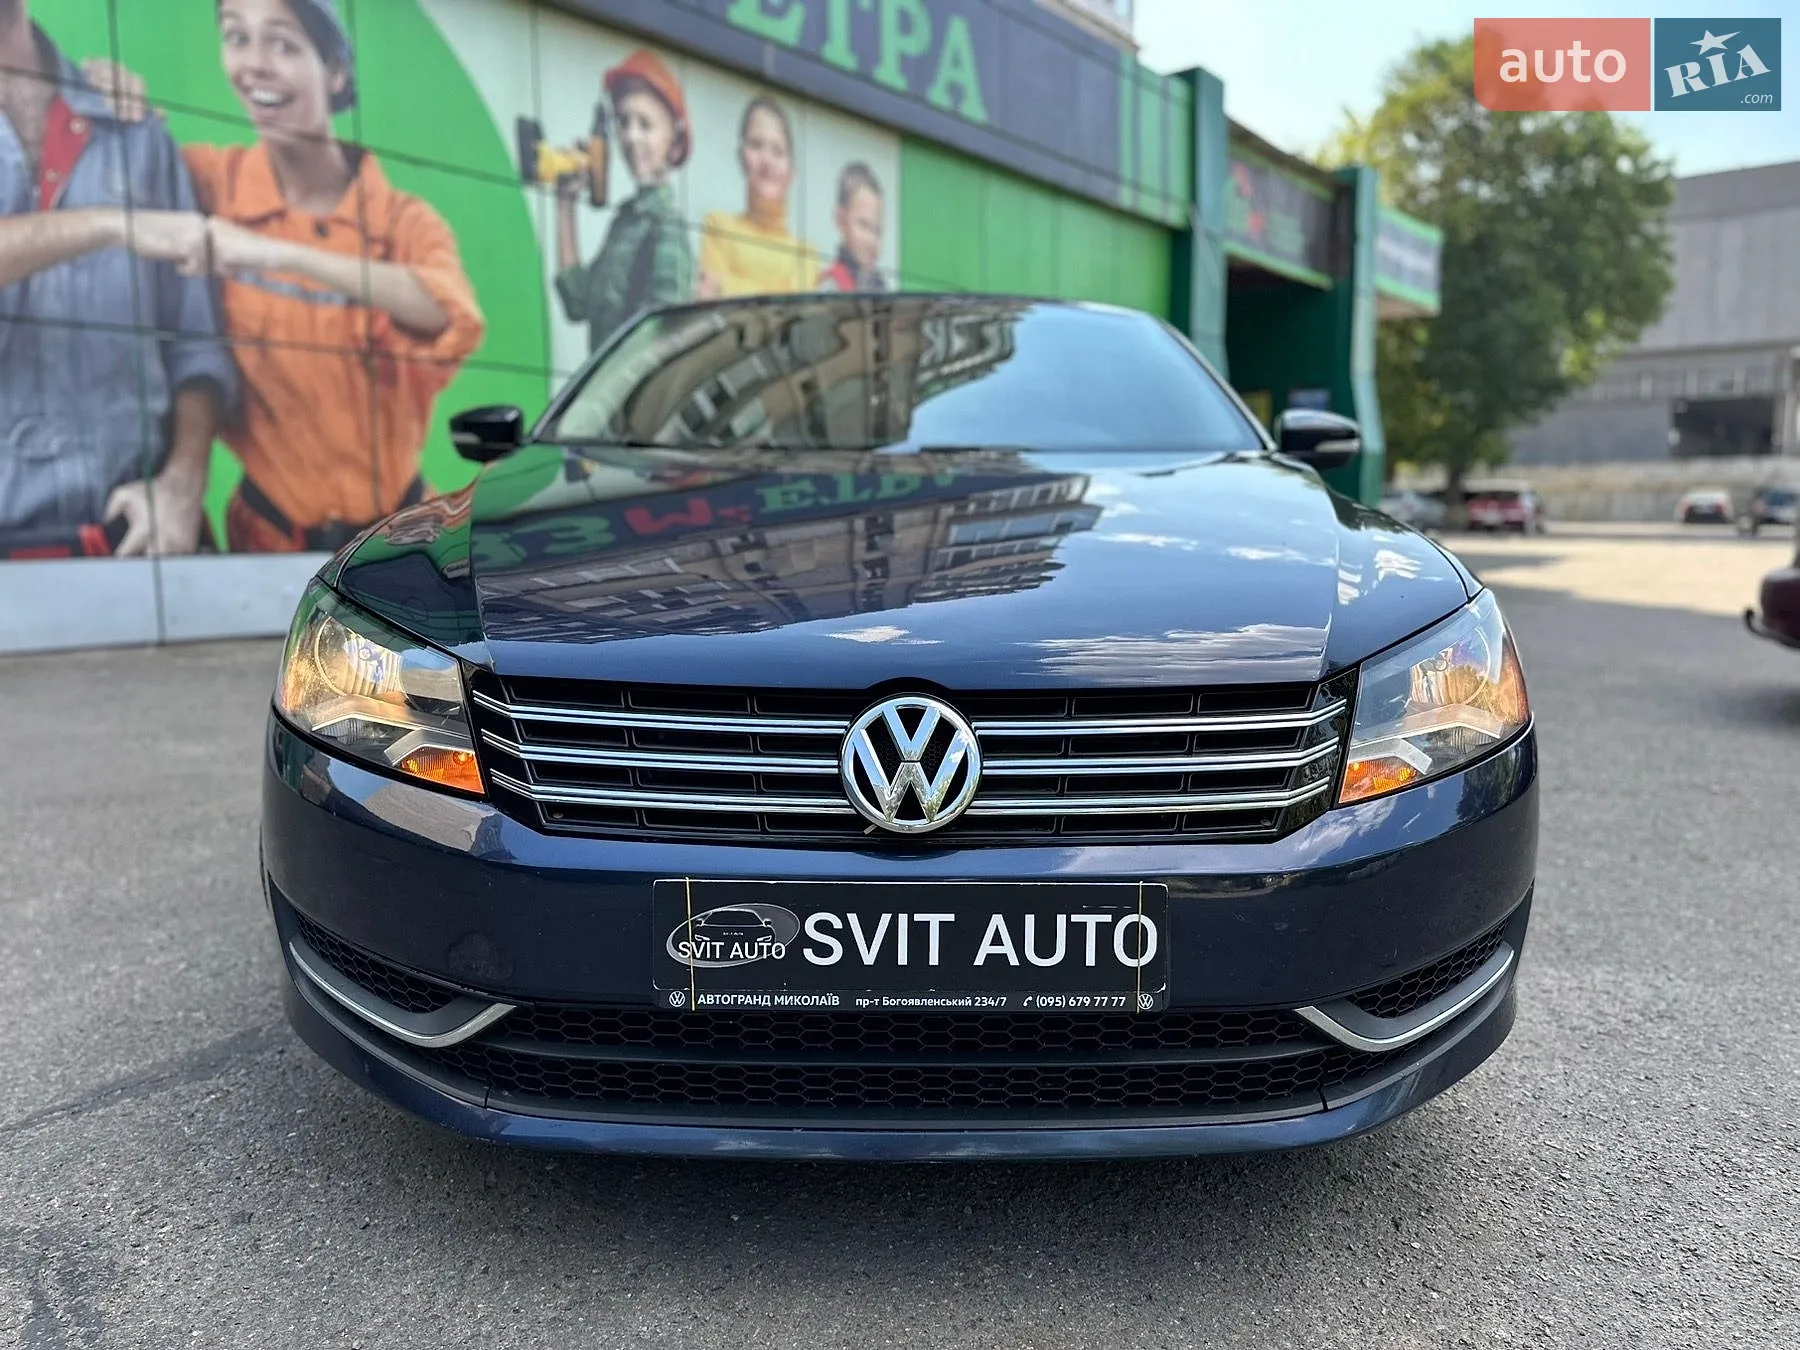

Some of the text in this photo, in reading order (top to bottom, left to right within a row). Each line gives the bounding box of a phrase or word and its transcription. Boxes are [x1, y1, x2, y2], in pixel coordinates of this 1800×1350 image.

[845, 699, 977, 828] VW
[802, 911, 1158, 968] SVIT AUTO
[678, 941, 787, 960] SVIT AUTO
[696, 992, 841, 1007] АВТОГРАНД МИКОЛАЇВ
[855, 996, 1007, 1008] пр-т Богоявленський 234/7
[1035, 996, 1127, 1008] (095) 679 77 77
